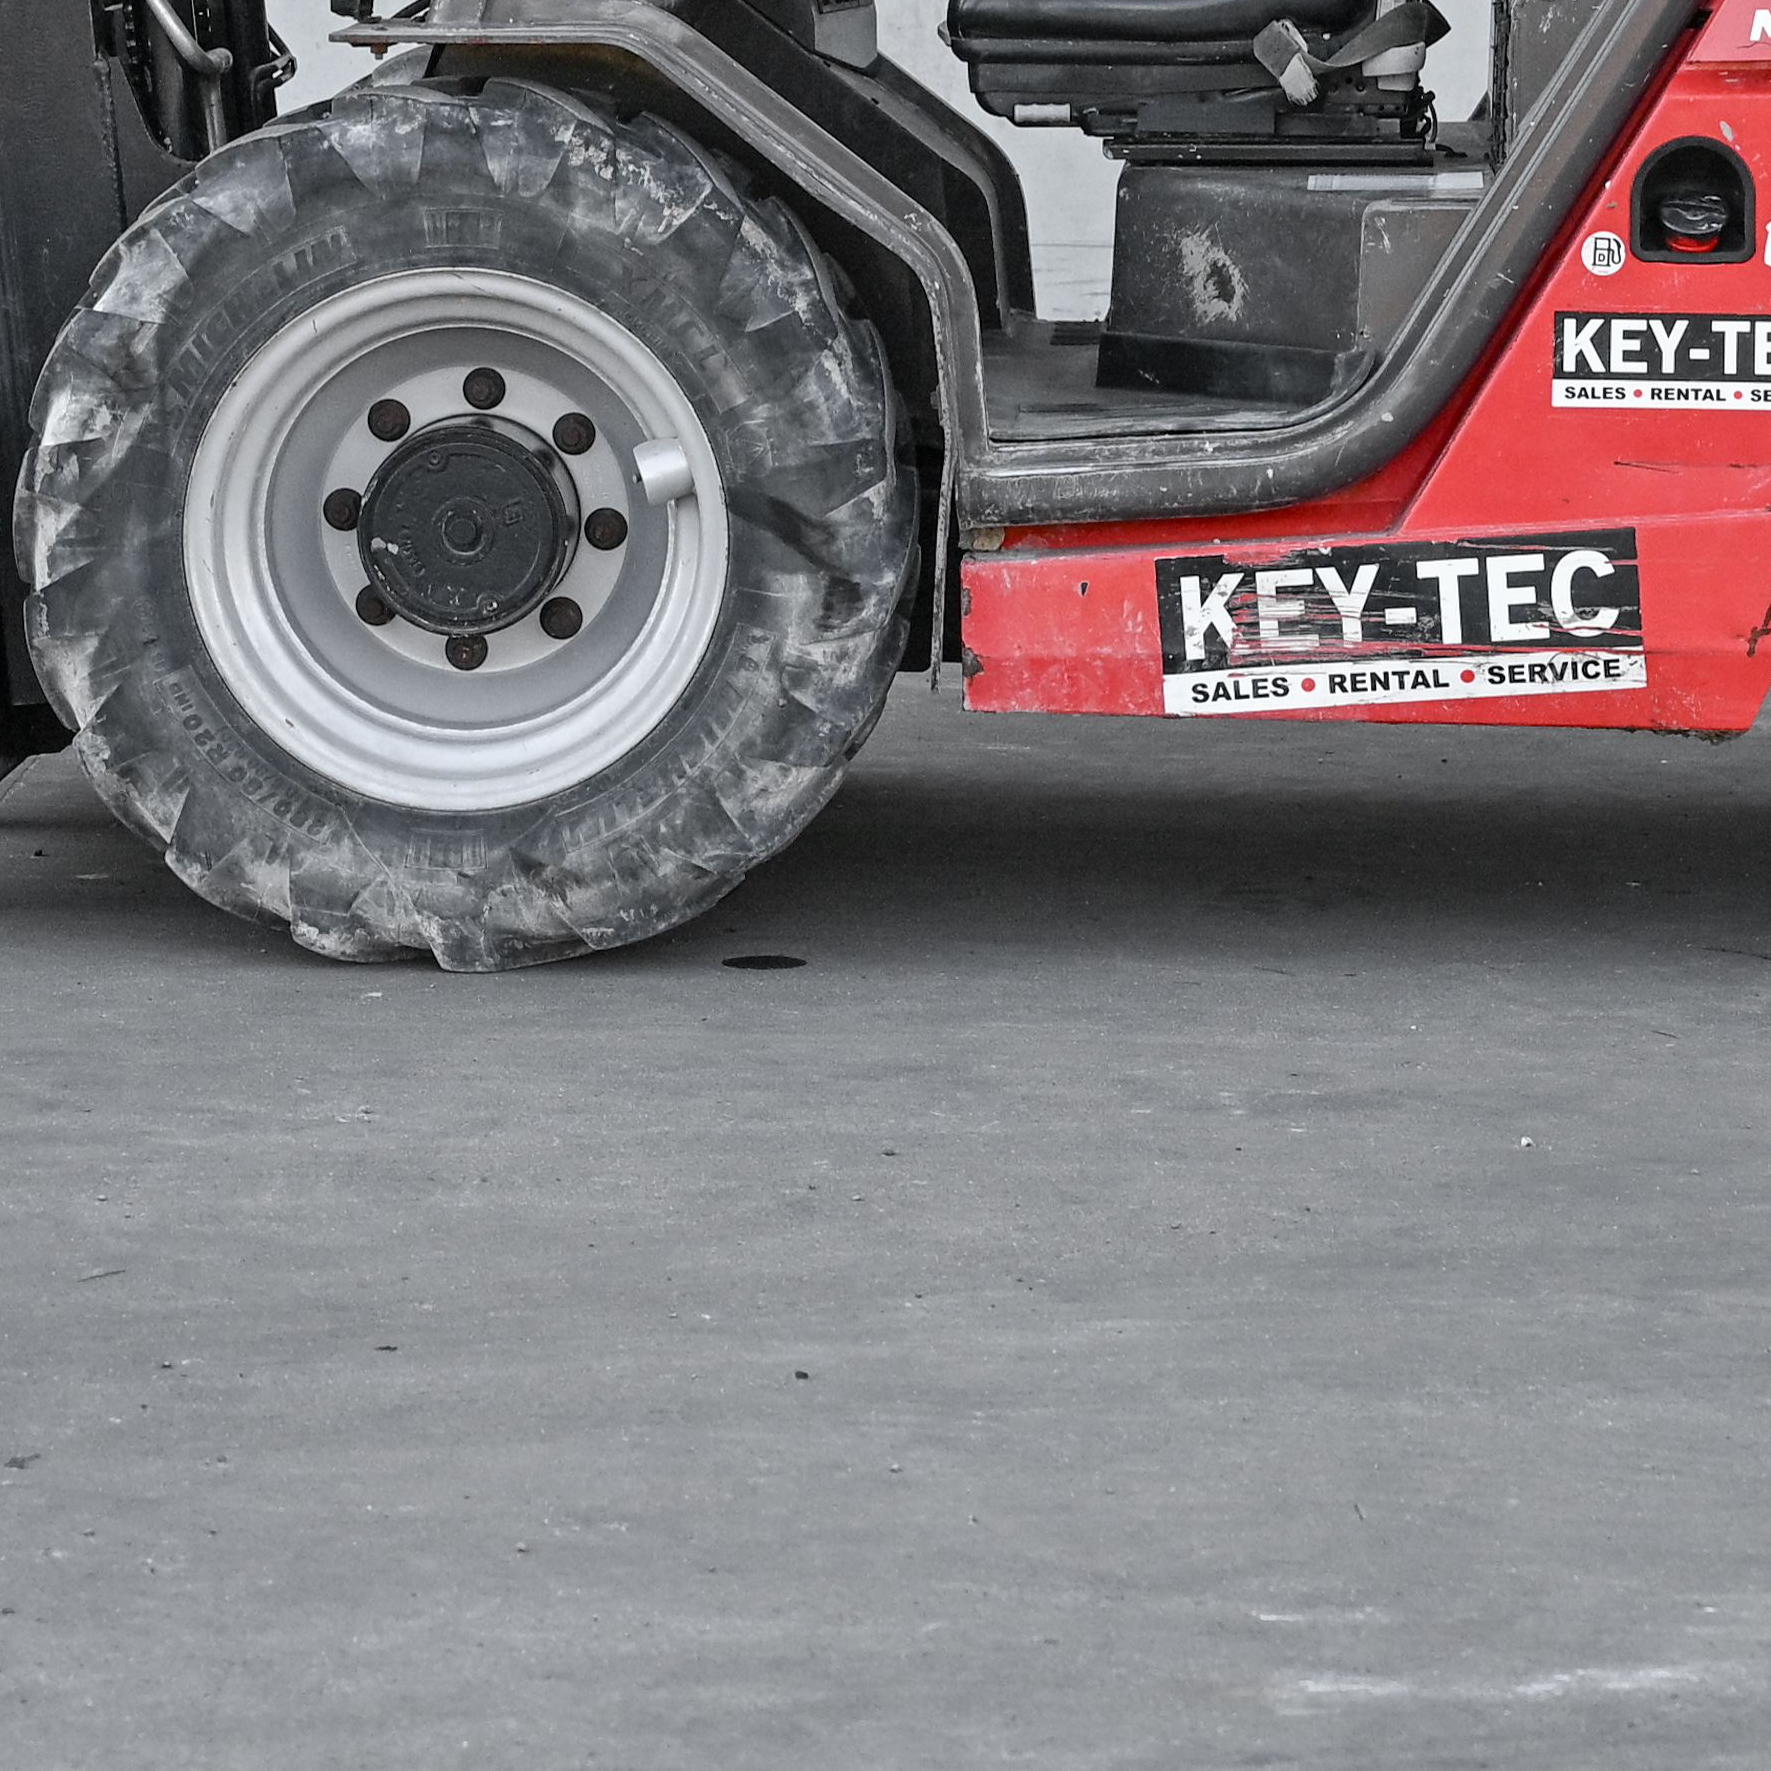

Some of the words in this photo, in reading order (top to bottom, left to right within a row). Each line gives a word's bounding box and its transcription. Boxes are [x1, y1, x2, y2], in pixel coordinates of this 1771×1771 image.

[1563, 385, 1627, 401] SALES
[1649, 387, 1727, 403] RENTAL
[1178, 549, 1621, 661] KEY-TEC
[1190, 675, 1290, 704] SALES
[1328, 667, 1451, 694] RENTAL
[1487, 657, 1622, 686] SERVICE
